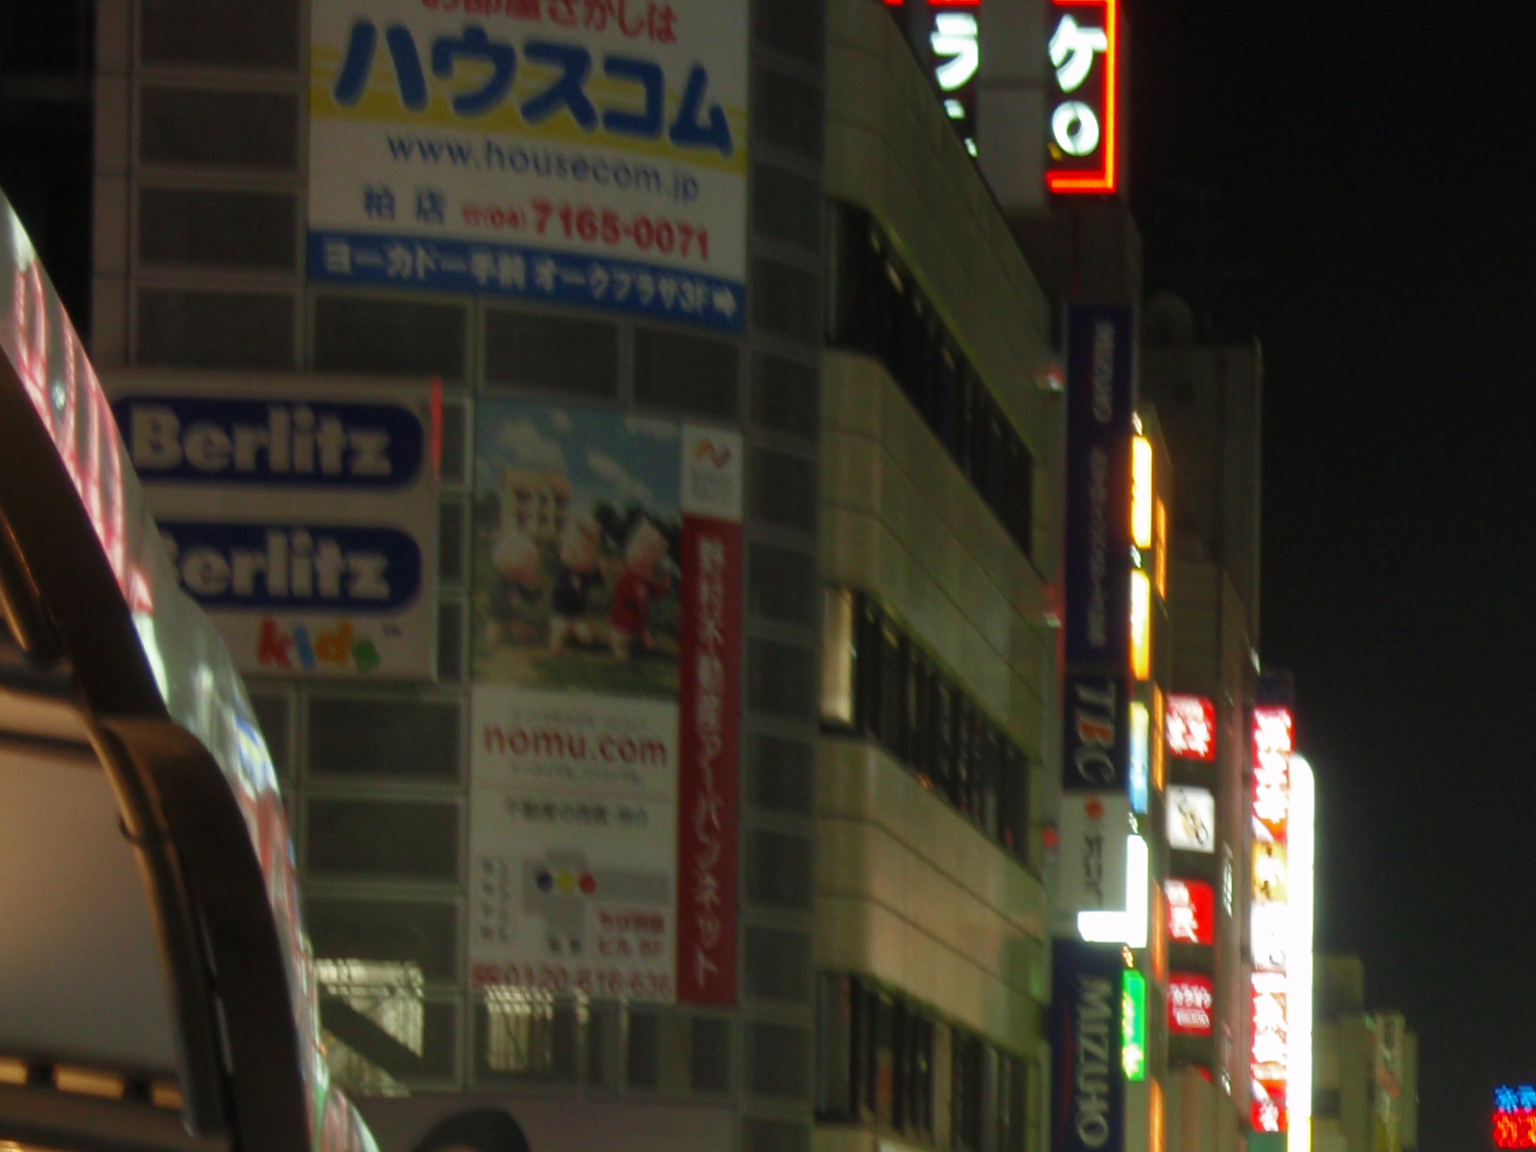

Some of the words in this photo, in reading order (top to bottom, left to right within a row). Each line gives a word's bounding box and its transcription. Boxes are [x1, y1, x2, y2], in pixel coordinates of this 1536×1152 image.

[335, 20, 734, 156] ハウスコム
[386, 131, 701, 203] www.housecom.jp
[130, 405, 391, 475] Berlitz
[164, 526, 391, 600] erlitz
[483, 723, 668, 767] nomu.com
[1074, 676, 1117, 785] TBC
[1075, 973, 1113, 1151] MIZUHO
